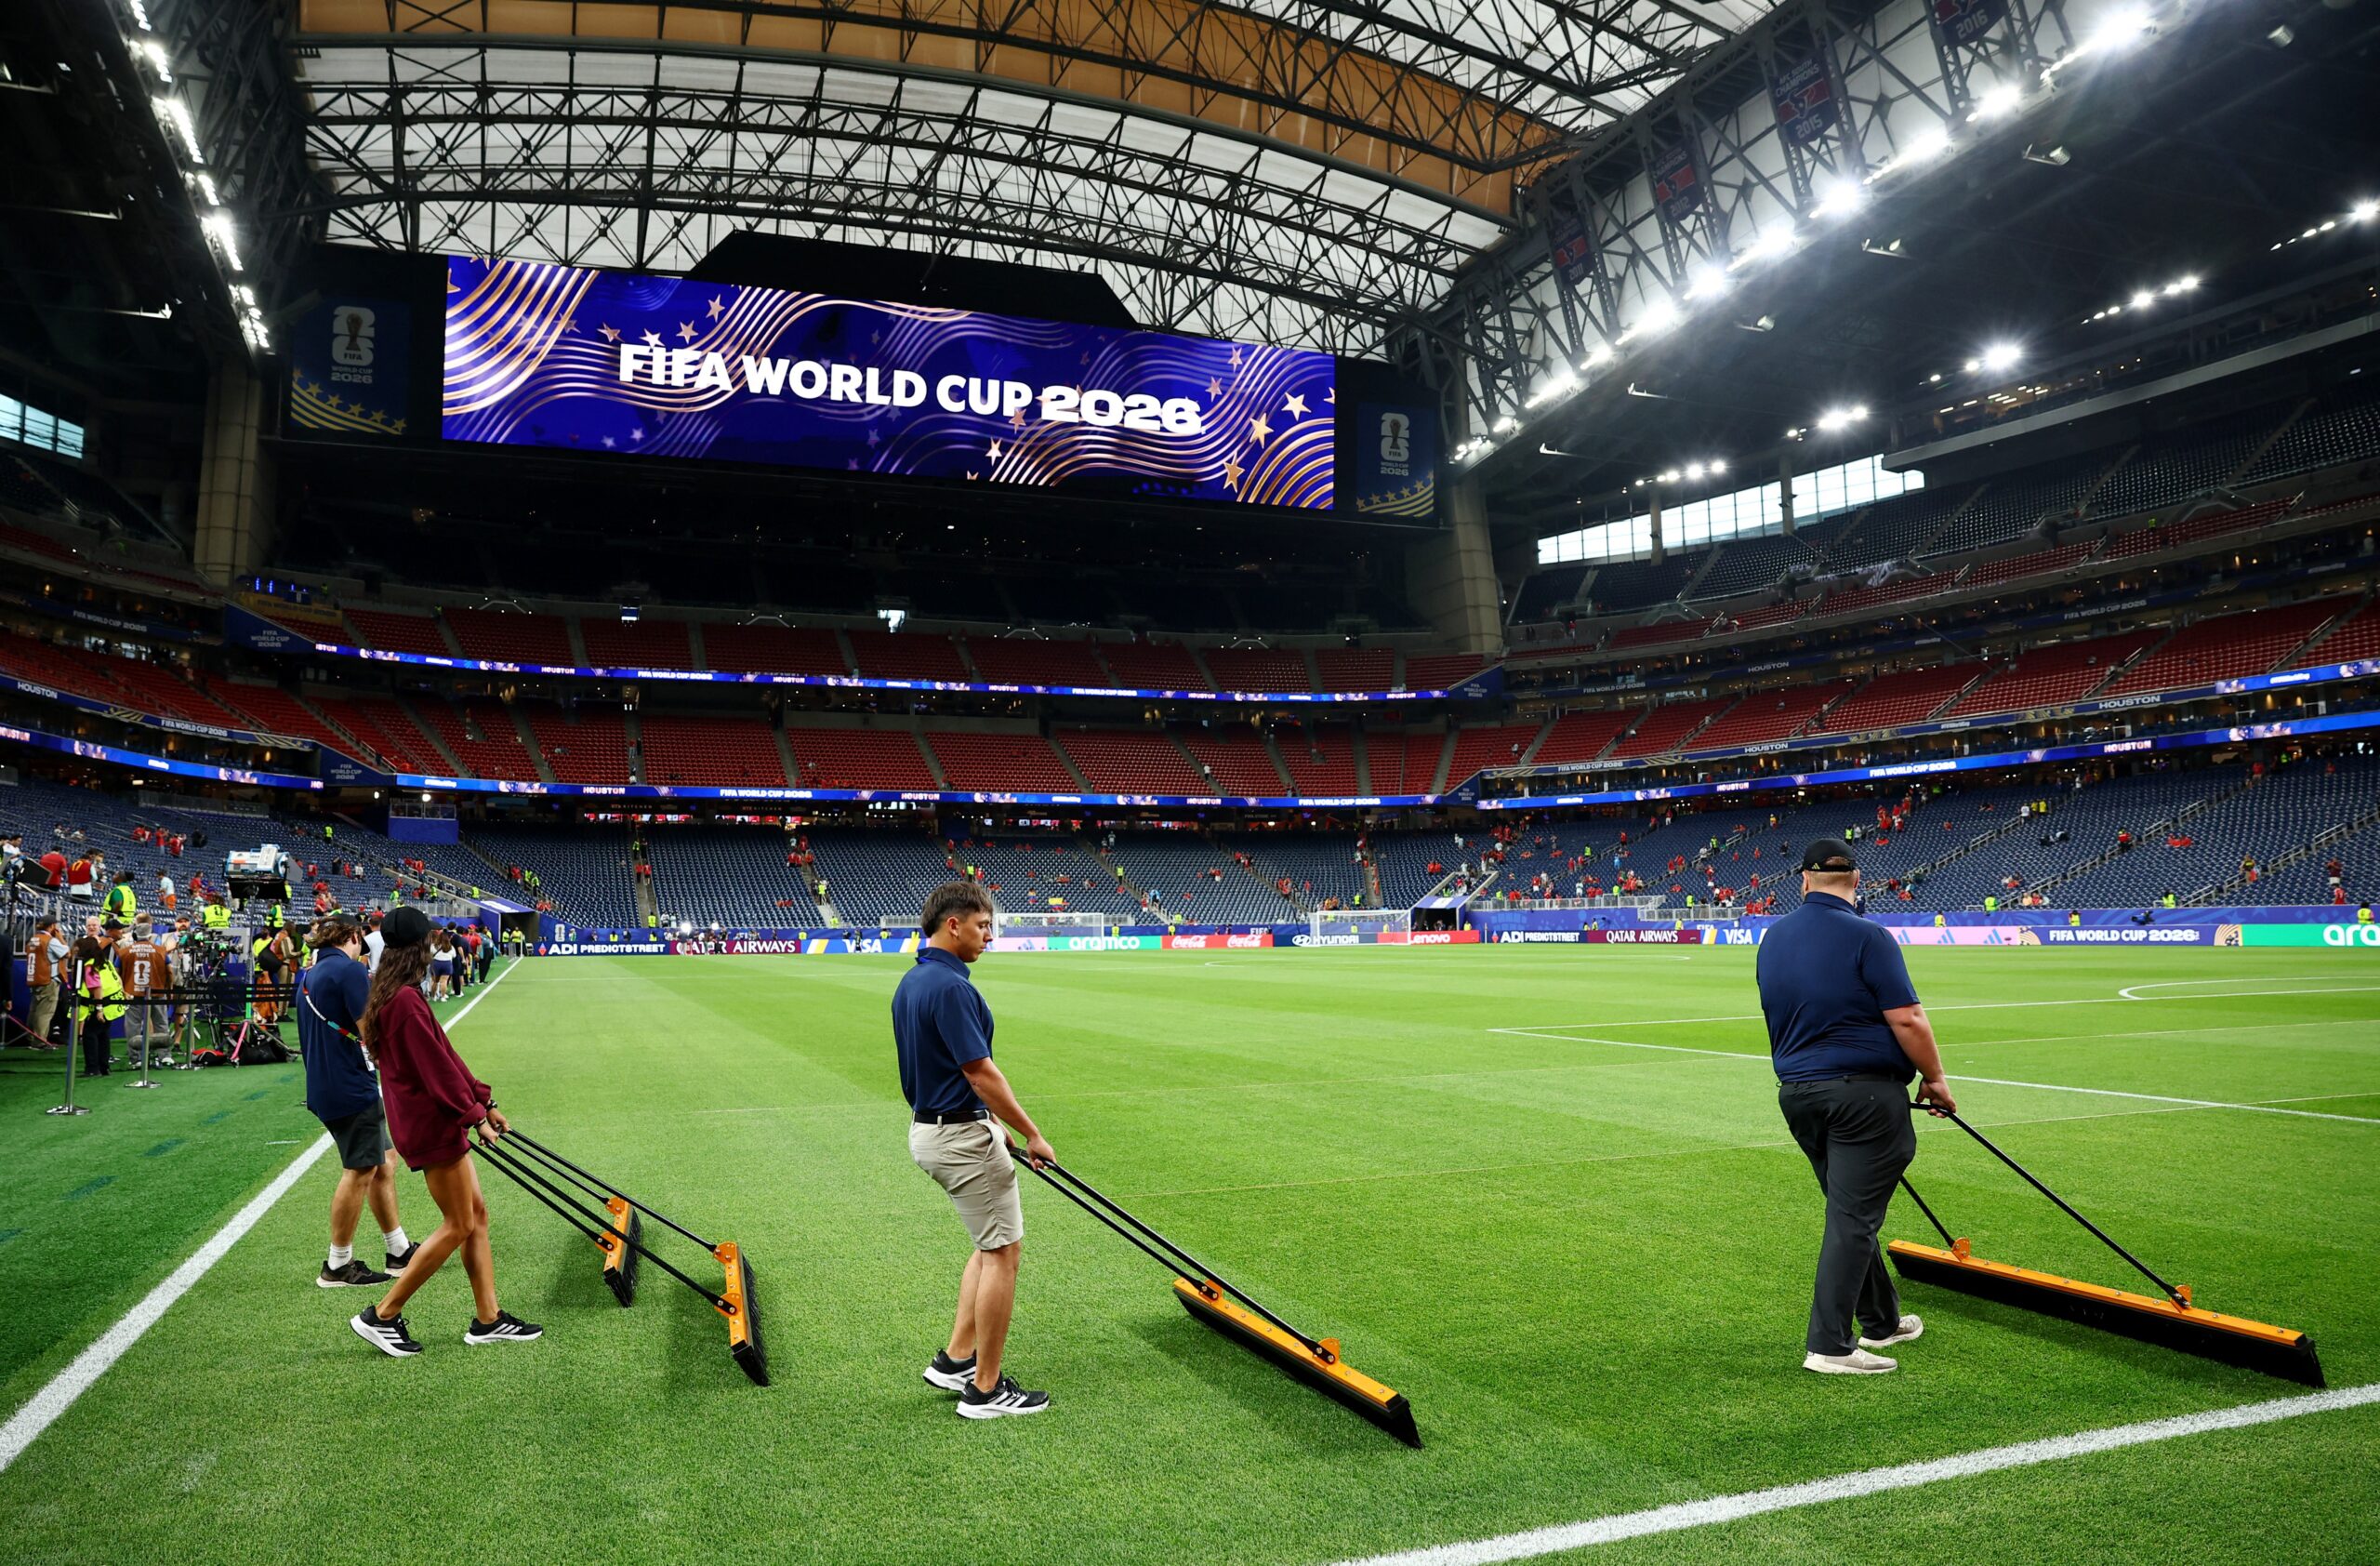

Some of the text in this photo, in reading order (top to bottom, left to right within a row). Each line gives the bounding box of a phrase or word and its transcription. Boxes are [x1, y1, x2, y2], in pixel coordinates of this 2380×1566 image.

[1956, 9, 1988, 39] 2016
[1795, 113, 1823, 139] 2015
[331, 372, 373, 384] 2026
[619, 343, 1202, 434] FIFA WORLD CUP 2026
[1381, 467, 1409, 476] 2026
[541, 665, 575, 675] HOUSTON
[1747, 661, 1790, 673] HOUSTON
[17, 681, 58, 699] HOUSTON
[2098, 695, 2162, 710] HOUSTON
[161, 720, 175, 728] FIFA
[175, 722, 196, 732] WORLD
[1744, 742, 1789, 753] HOUSTON
[2103, 739, 2152, 753] HOUSTON
[1870, 768, 1886, 778] FIFA
[1885, 765, 1913, 776] WORLD
[1912, 763, 1929, 774] CUP
[583, 787, 626, 795] HOUSTON
[1716, 781, 1750, 792] HOUSTON
[720, 789, 738, 797] FIFA
[738, 790, 768, 798] WORLD
[1186, 797, 1222, 805] HOUSTON
[1298, 798, 1315, 806] FIFA
[1314, 798, 1341, 806] WORLD
[1340, 798, 1355, 806] CUP
[1500, 931, 1580, 943] ADI PREDICTSTREET
[1606, 930, 1679, 944] QATAR AIRWAYS
[1724, 929, 1753, 944] VISA
[2049, 930, 2196, 942] FIFA WORLD CUP 2026
[549, 943, 577, 955] ADI
[733, 940, 796, 954] AIRWAYS
[842, 938, 882, 953] VSA
[1068, 936, 1141, 950] aramco
